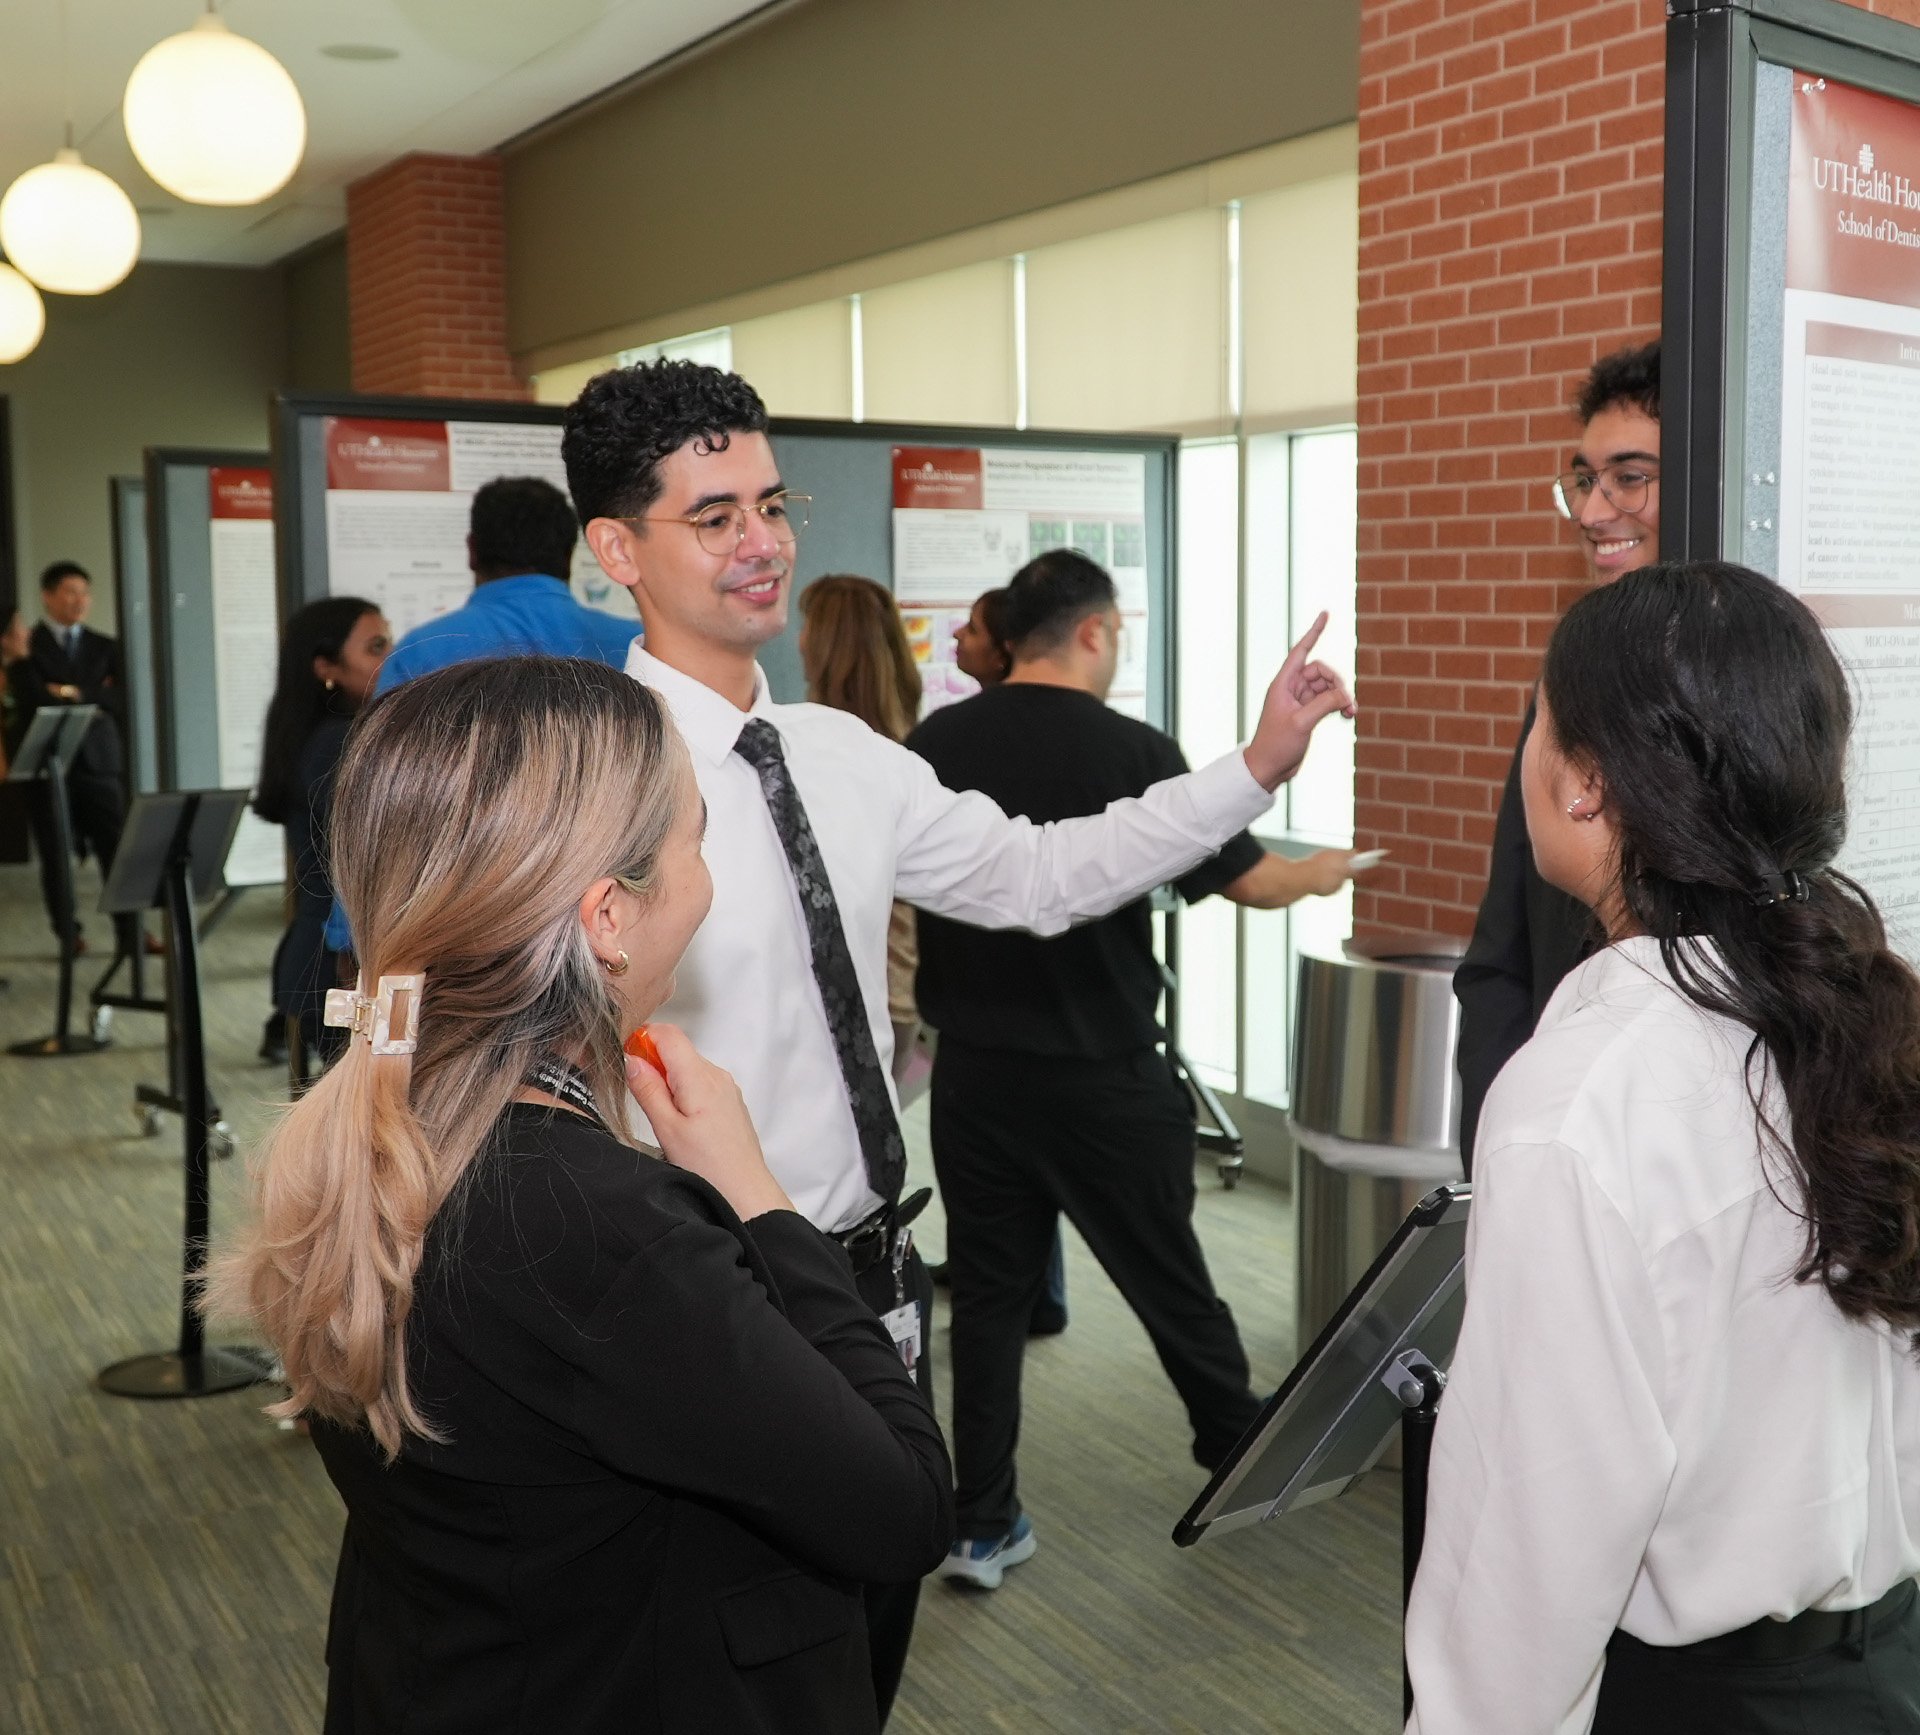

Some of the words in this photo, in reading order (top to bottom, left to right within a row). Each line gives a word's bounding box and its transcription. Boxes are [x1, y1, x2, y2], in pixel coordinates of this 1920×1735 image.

[1813, 156, 1892, 204] UTHealth
[1838, 210, 1873, 238] School
[1875, 218, 1888, 241] of
